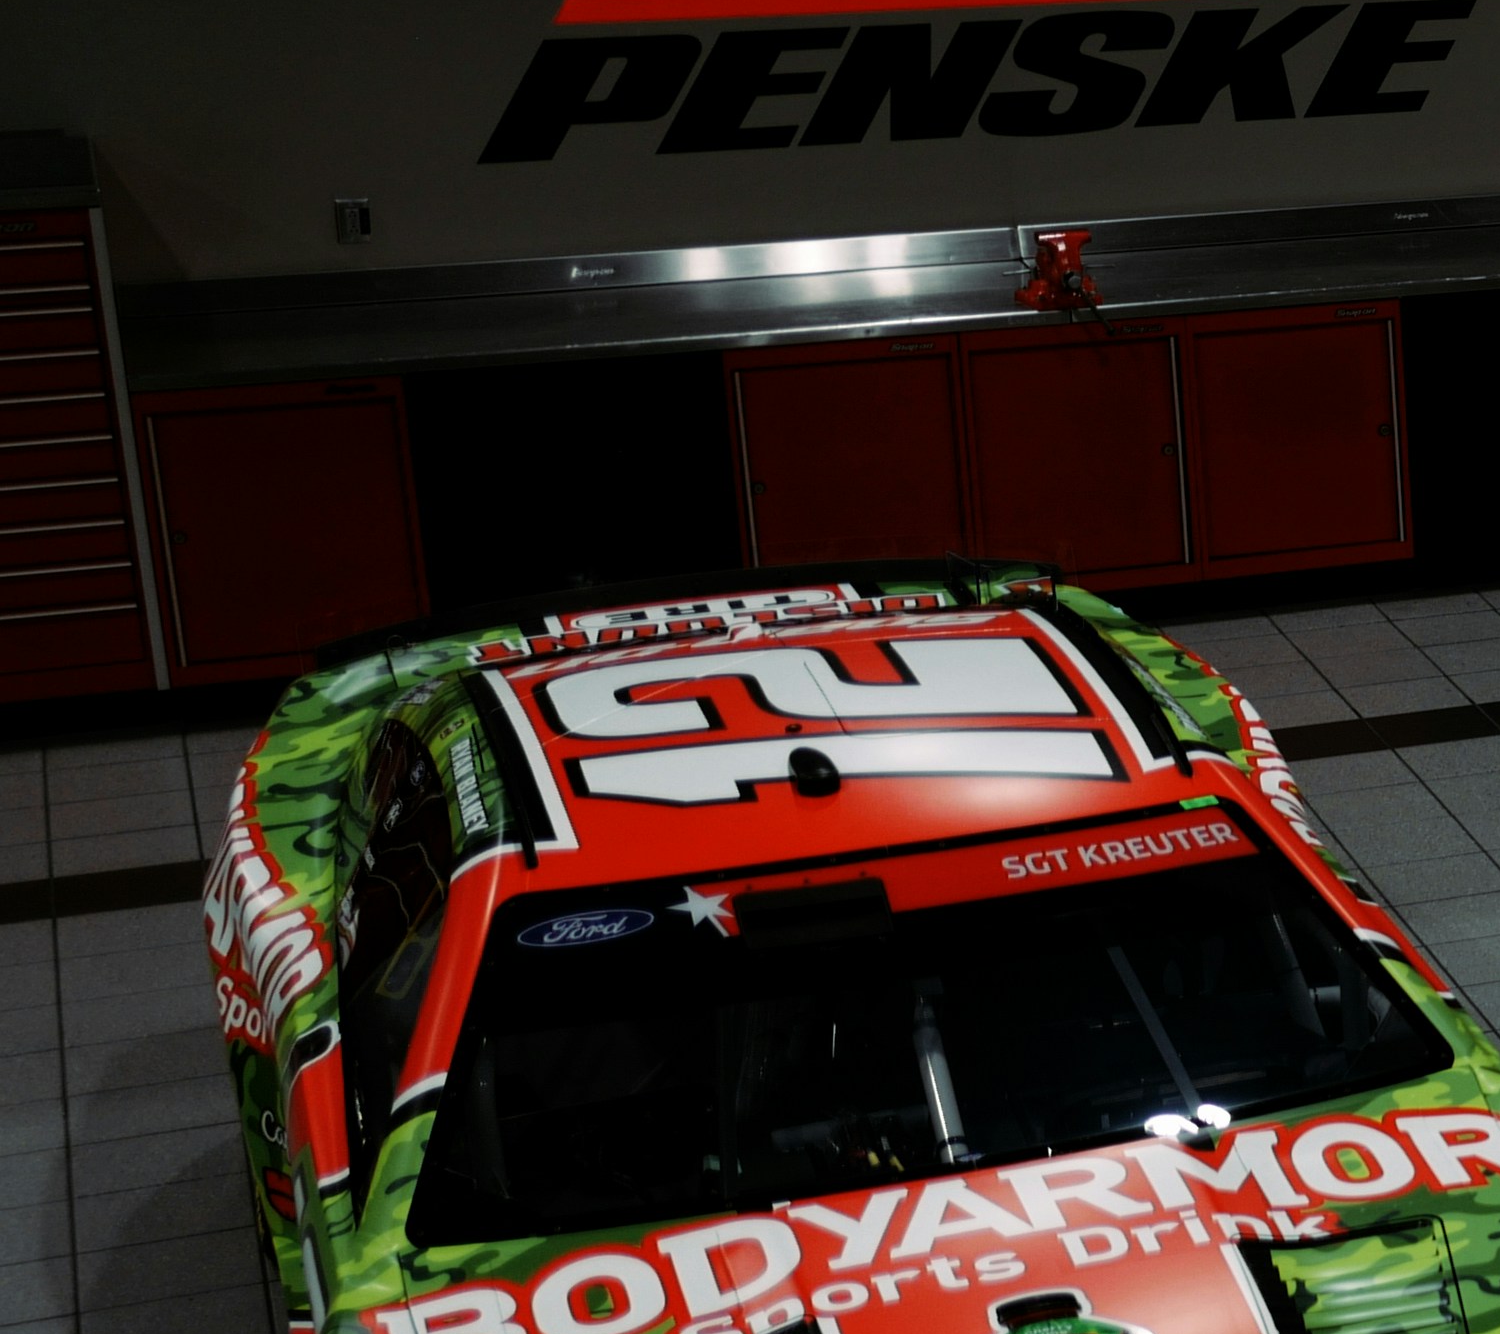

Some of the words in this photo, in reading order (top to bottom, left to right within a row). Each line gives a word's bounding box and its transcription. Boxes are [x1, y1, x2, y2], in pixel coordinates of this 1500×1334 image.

[467, 593, 946, 666] DISCOUNT
[602, 593, 815, 623] TIRE
[533, 634, 1130, 810] 12
[449, 737, 478, 777] RYAN
[455, 773, 492, 836] BLANEY
[1000, 848, 1071, 882] SGT
[1080, 821, 1240, 869] KREUTER
[542, 910, 627, 944] Ford
[1057, 1197, 1338, 1269] Drink
